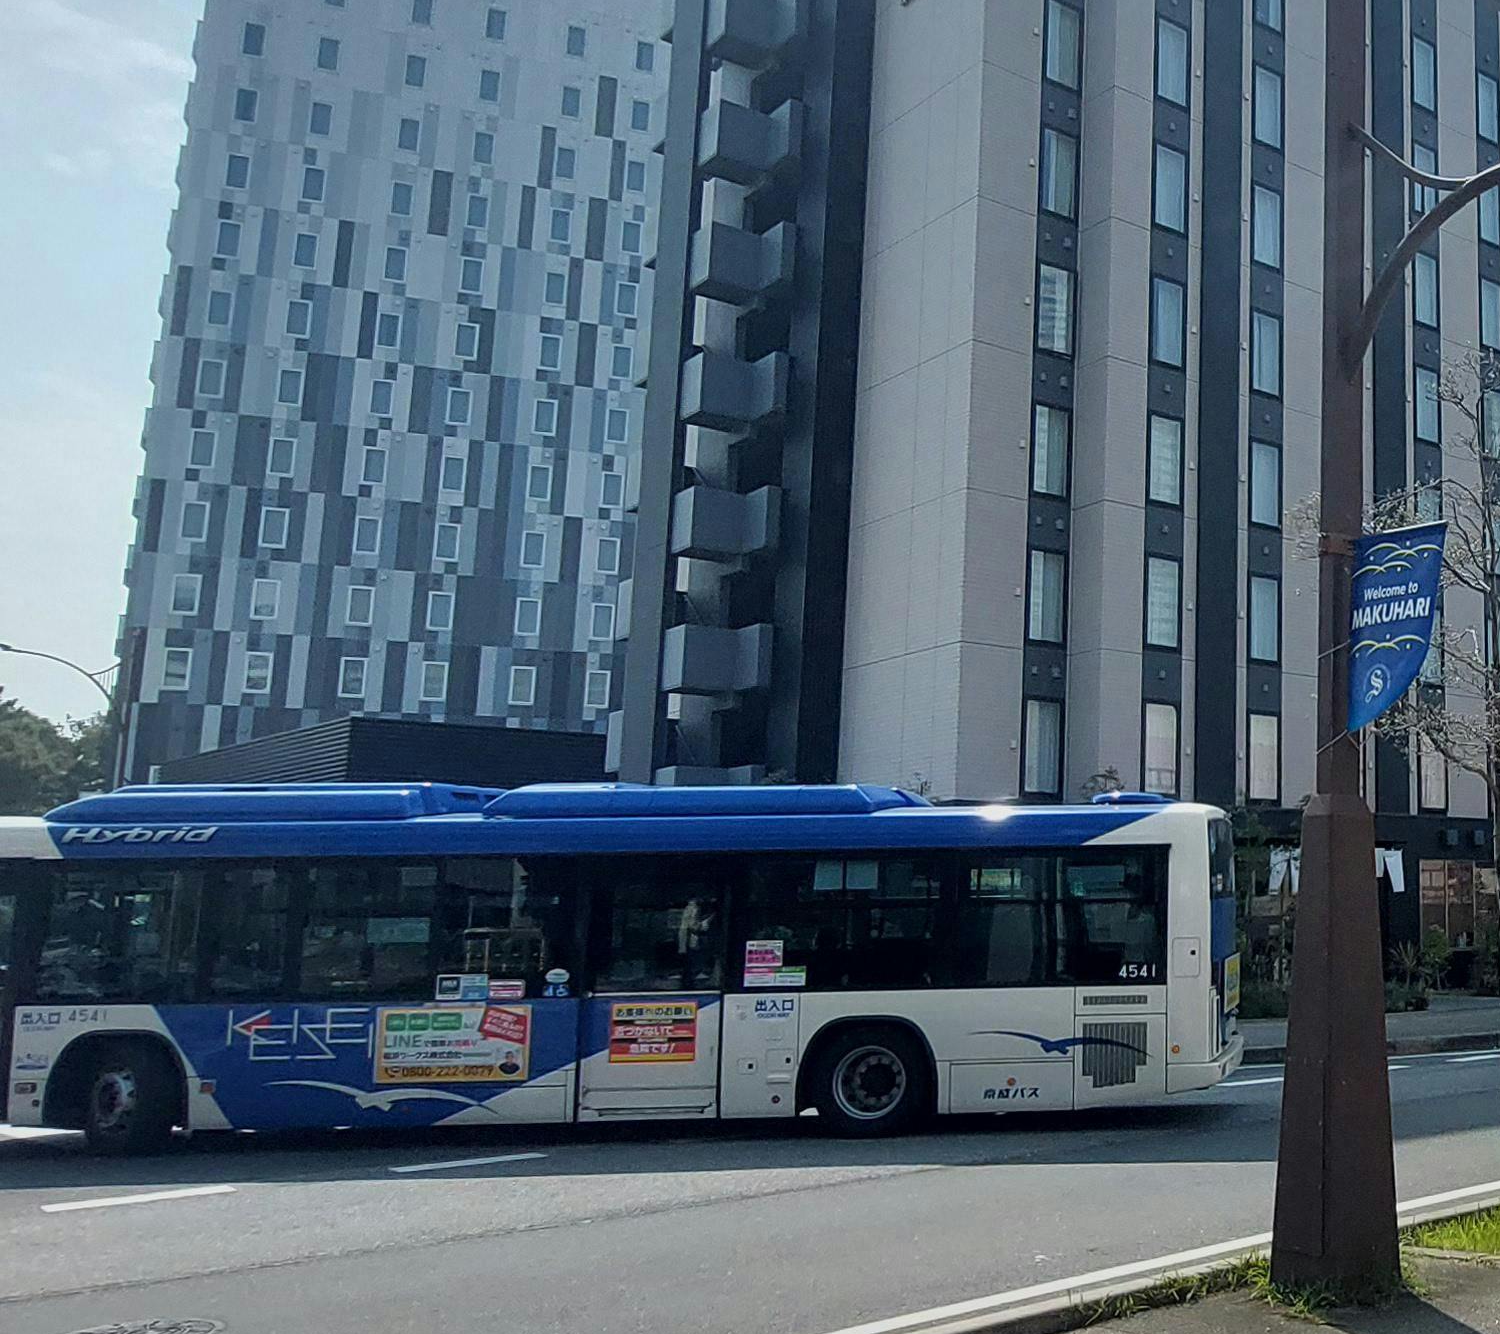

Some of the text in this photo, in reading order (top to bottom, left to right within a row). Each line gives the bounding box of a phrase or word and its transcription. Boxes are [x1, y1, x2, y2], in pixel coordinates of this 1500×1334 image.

[1364, 581, 1419, 602] Welcome to
[1351, 596, 1431, 630] MAKUHARI
[61, 826, 219, 844] Hybrid
[1118, 963, 1157, 979] 4541
[755, 999, 795, 1013] 出入口
[68, 1009, 107, 1023] 4541
[384, 1035, 421, 1048] LINE
[983, 1087, 1040, 1100] 京成バス
